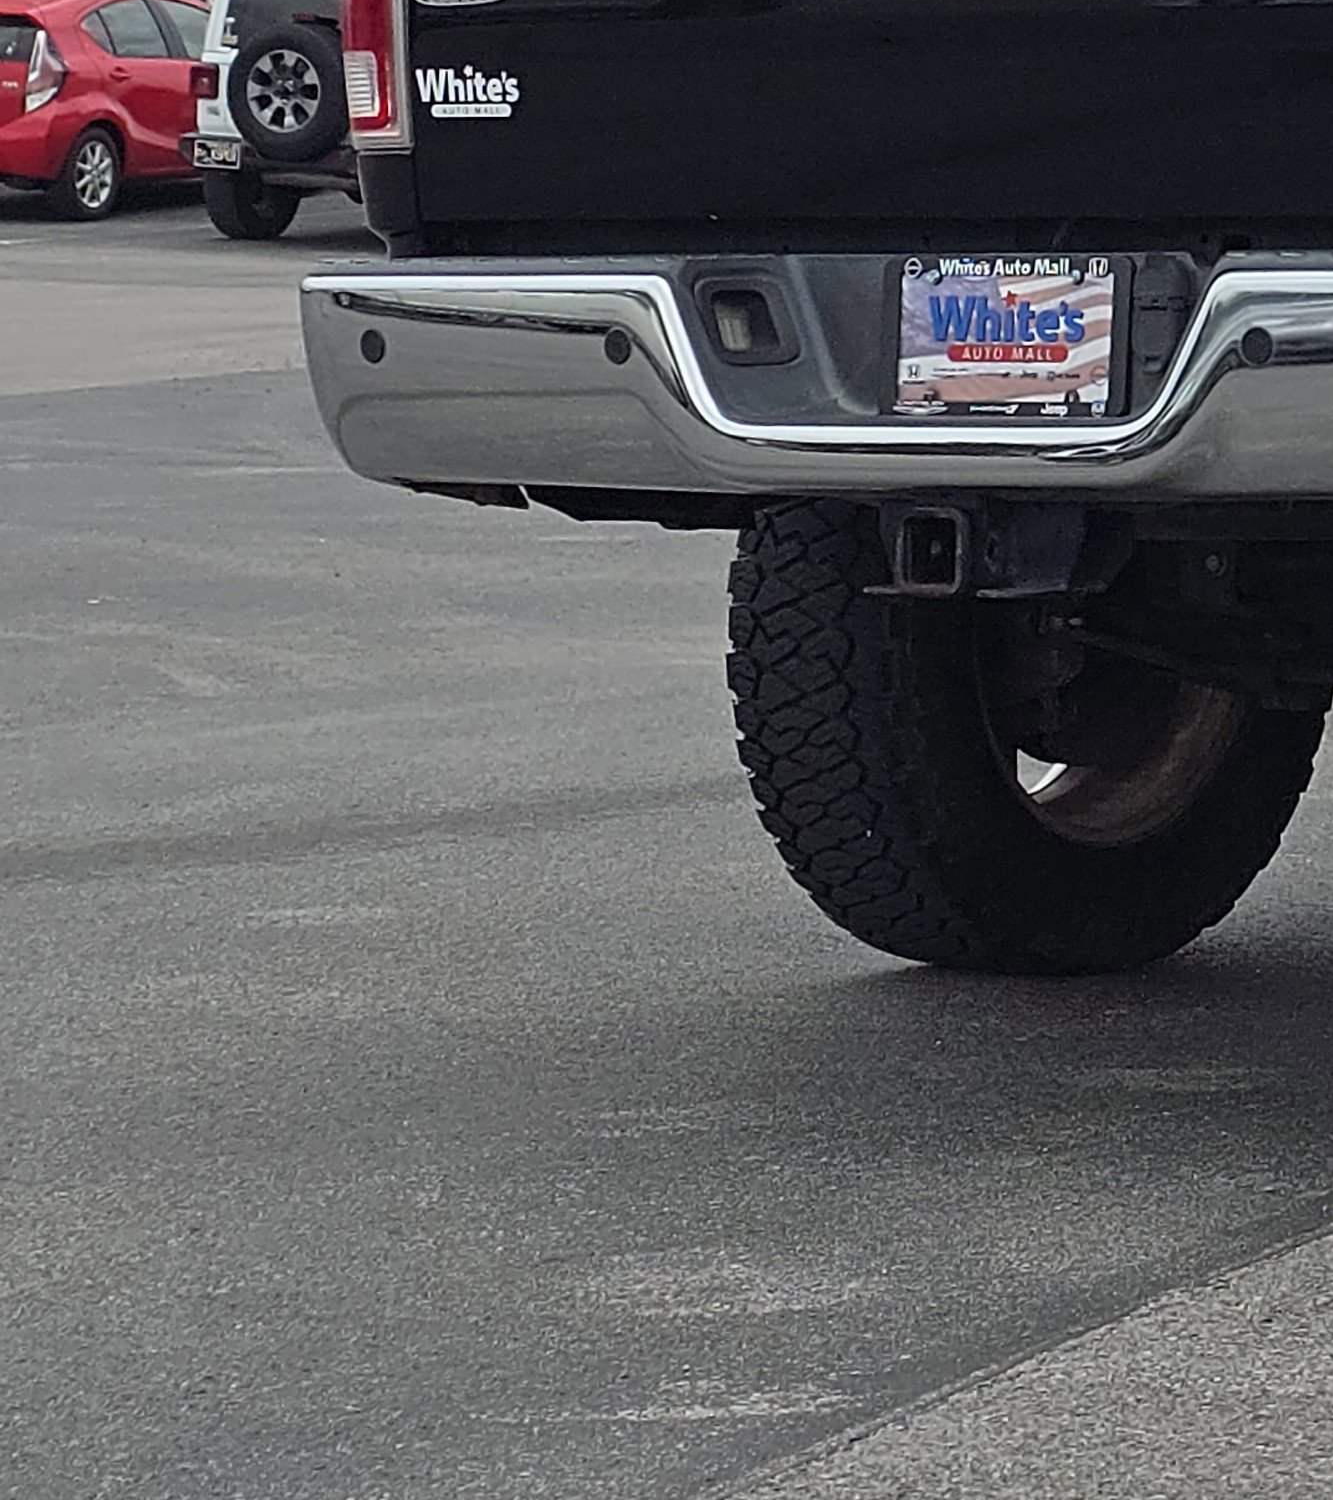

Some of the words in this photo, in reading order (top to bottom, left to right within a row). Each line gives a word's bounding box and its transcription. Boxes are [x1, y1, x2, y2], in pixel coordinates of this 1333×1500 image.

[415, 65, 521, 103] White's
[442, 106, 469, 115] AUTO
[474, 105, 502, 115] MALL
[939, 258, 991, 277] White's
[993, 258, 1032, 276] Auto
[1034, 258, 1070, 276] Mall
[928, 292, 1086, 344] White's
[961, 346, 1004, 361] AUTO
[1012, 346, 1053, 361] MALL
